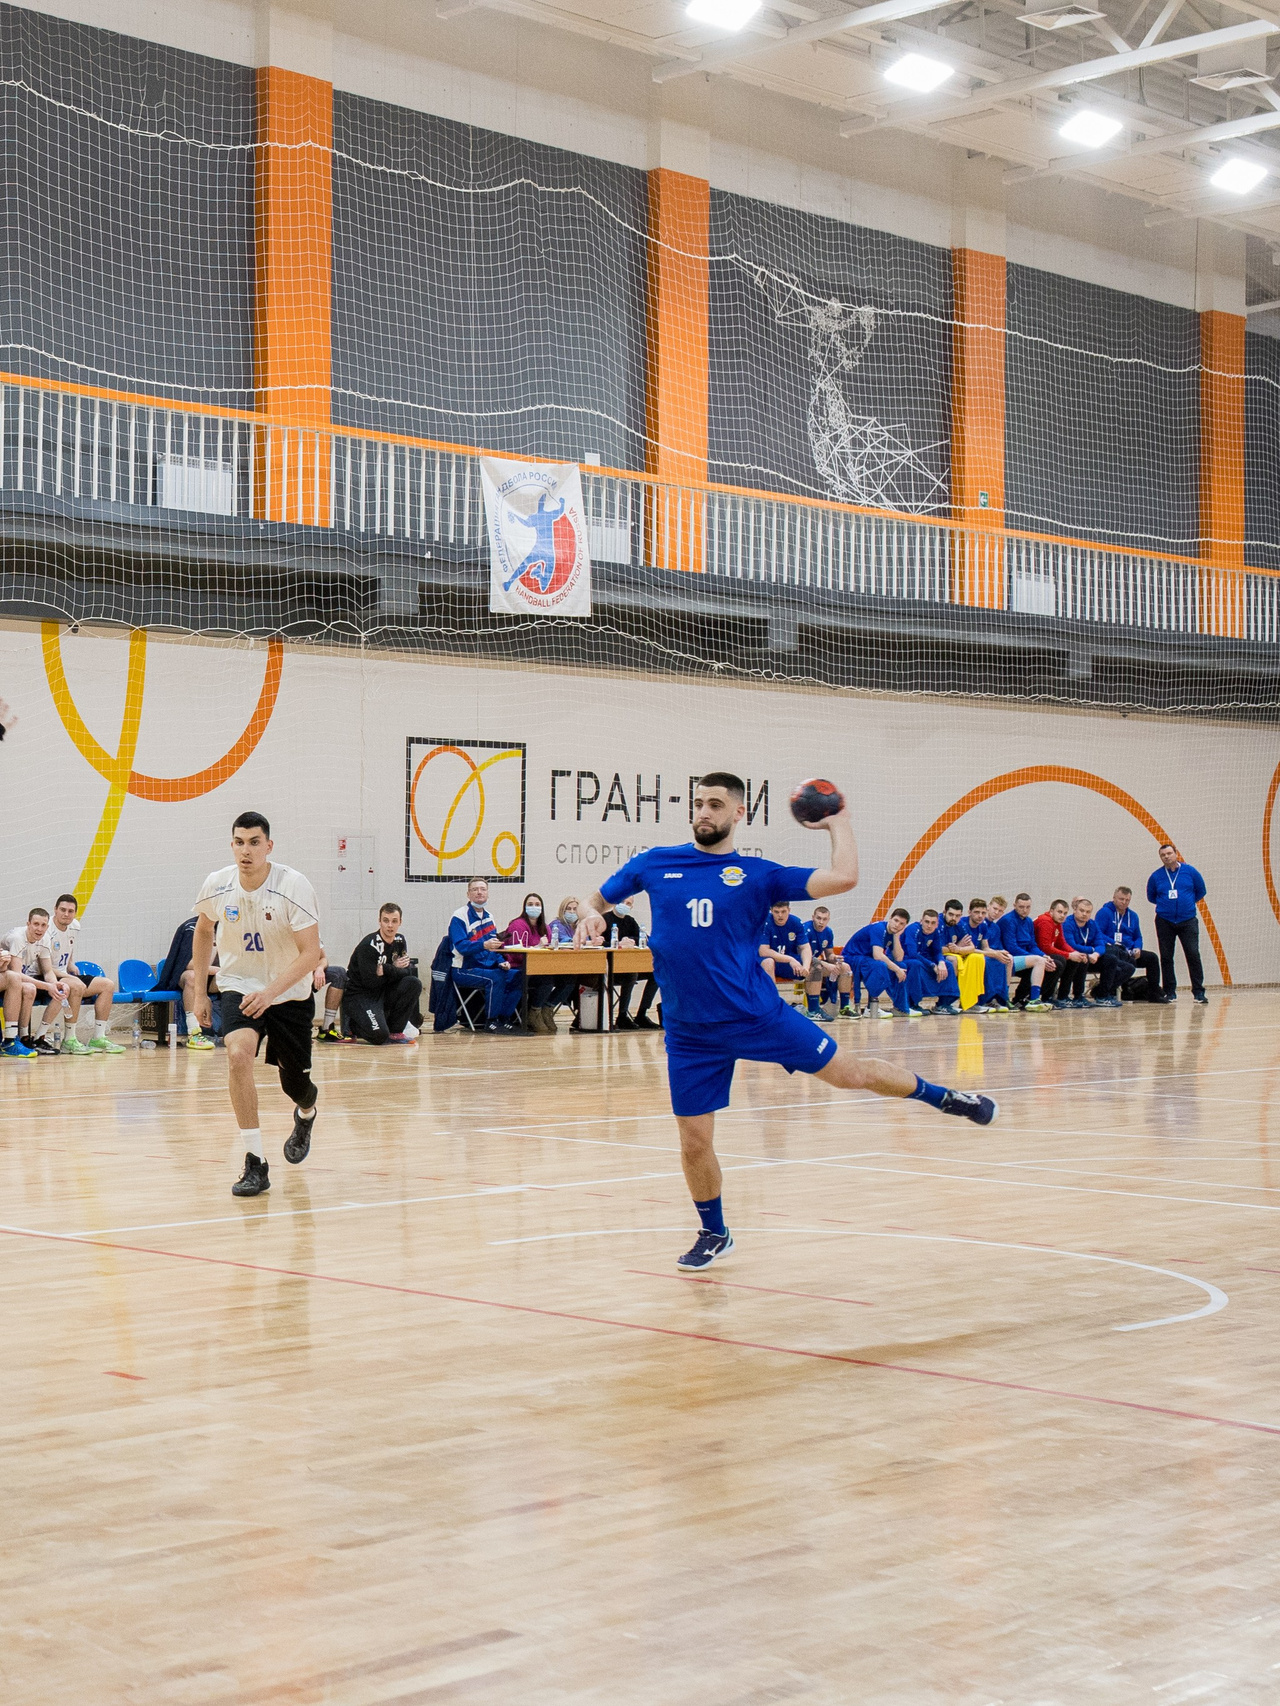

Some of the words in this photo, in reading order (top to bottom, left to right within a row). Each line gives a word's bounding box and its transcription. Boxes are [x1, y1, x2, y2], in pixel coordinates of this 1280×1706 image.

[568, 507, 583, 544] RUSSIA
[577, 548, 584, 560] OF
[551, 562, 583, 606] FEDERATION
[515, 585, 551, 607] HANDBALL
[550, 769, 769, 826] ГРАН-ПИ
[685, 898, 713, 928] 10
[243, 932, 264, 952] 20
[58, 953, 69, 967] 27
[141, 1012, 155, 1020] LIFE
[141, 1019, 157, 1028] LOUD
